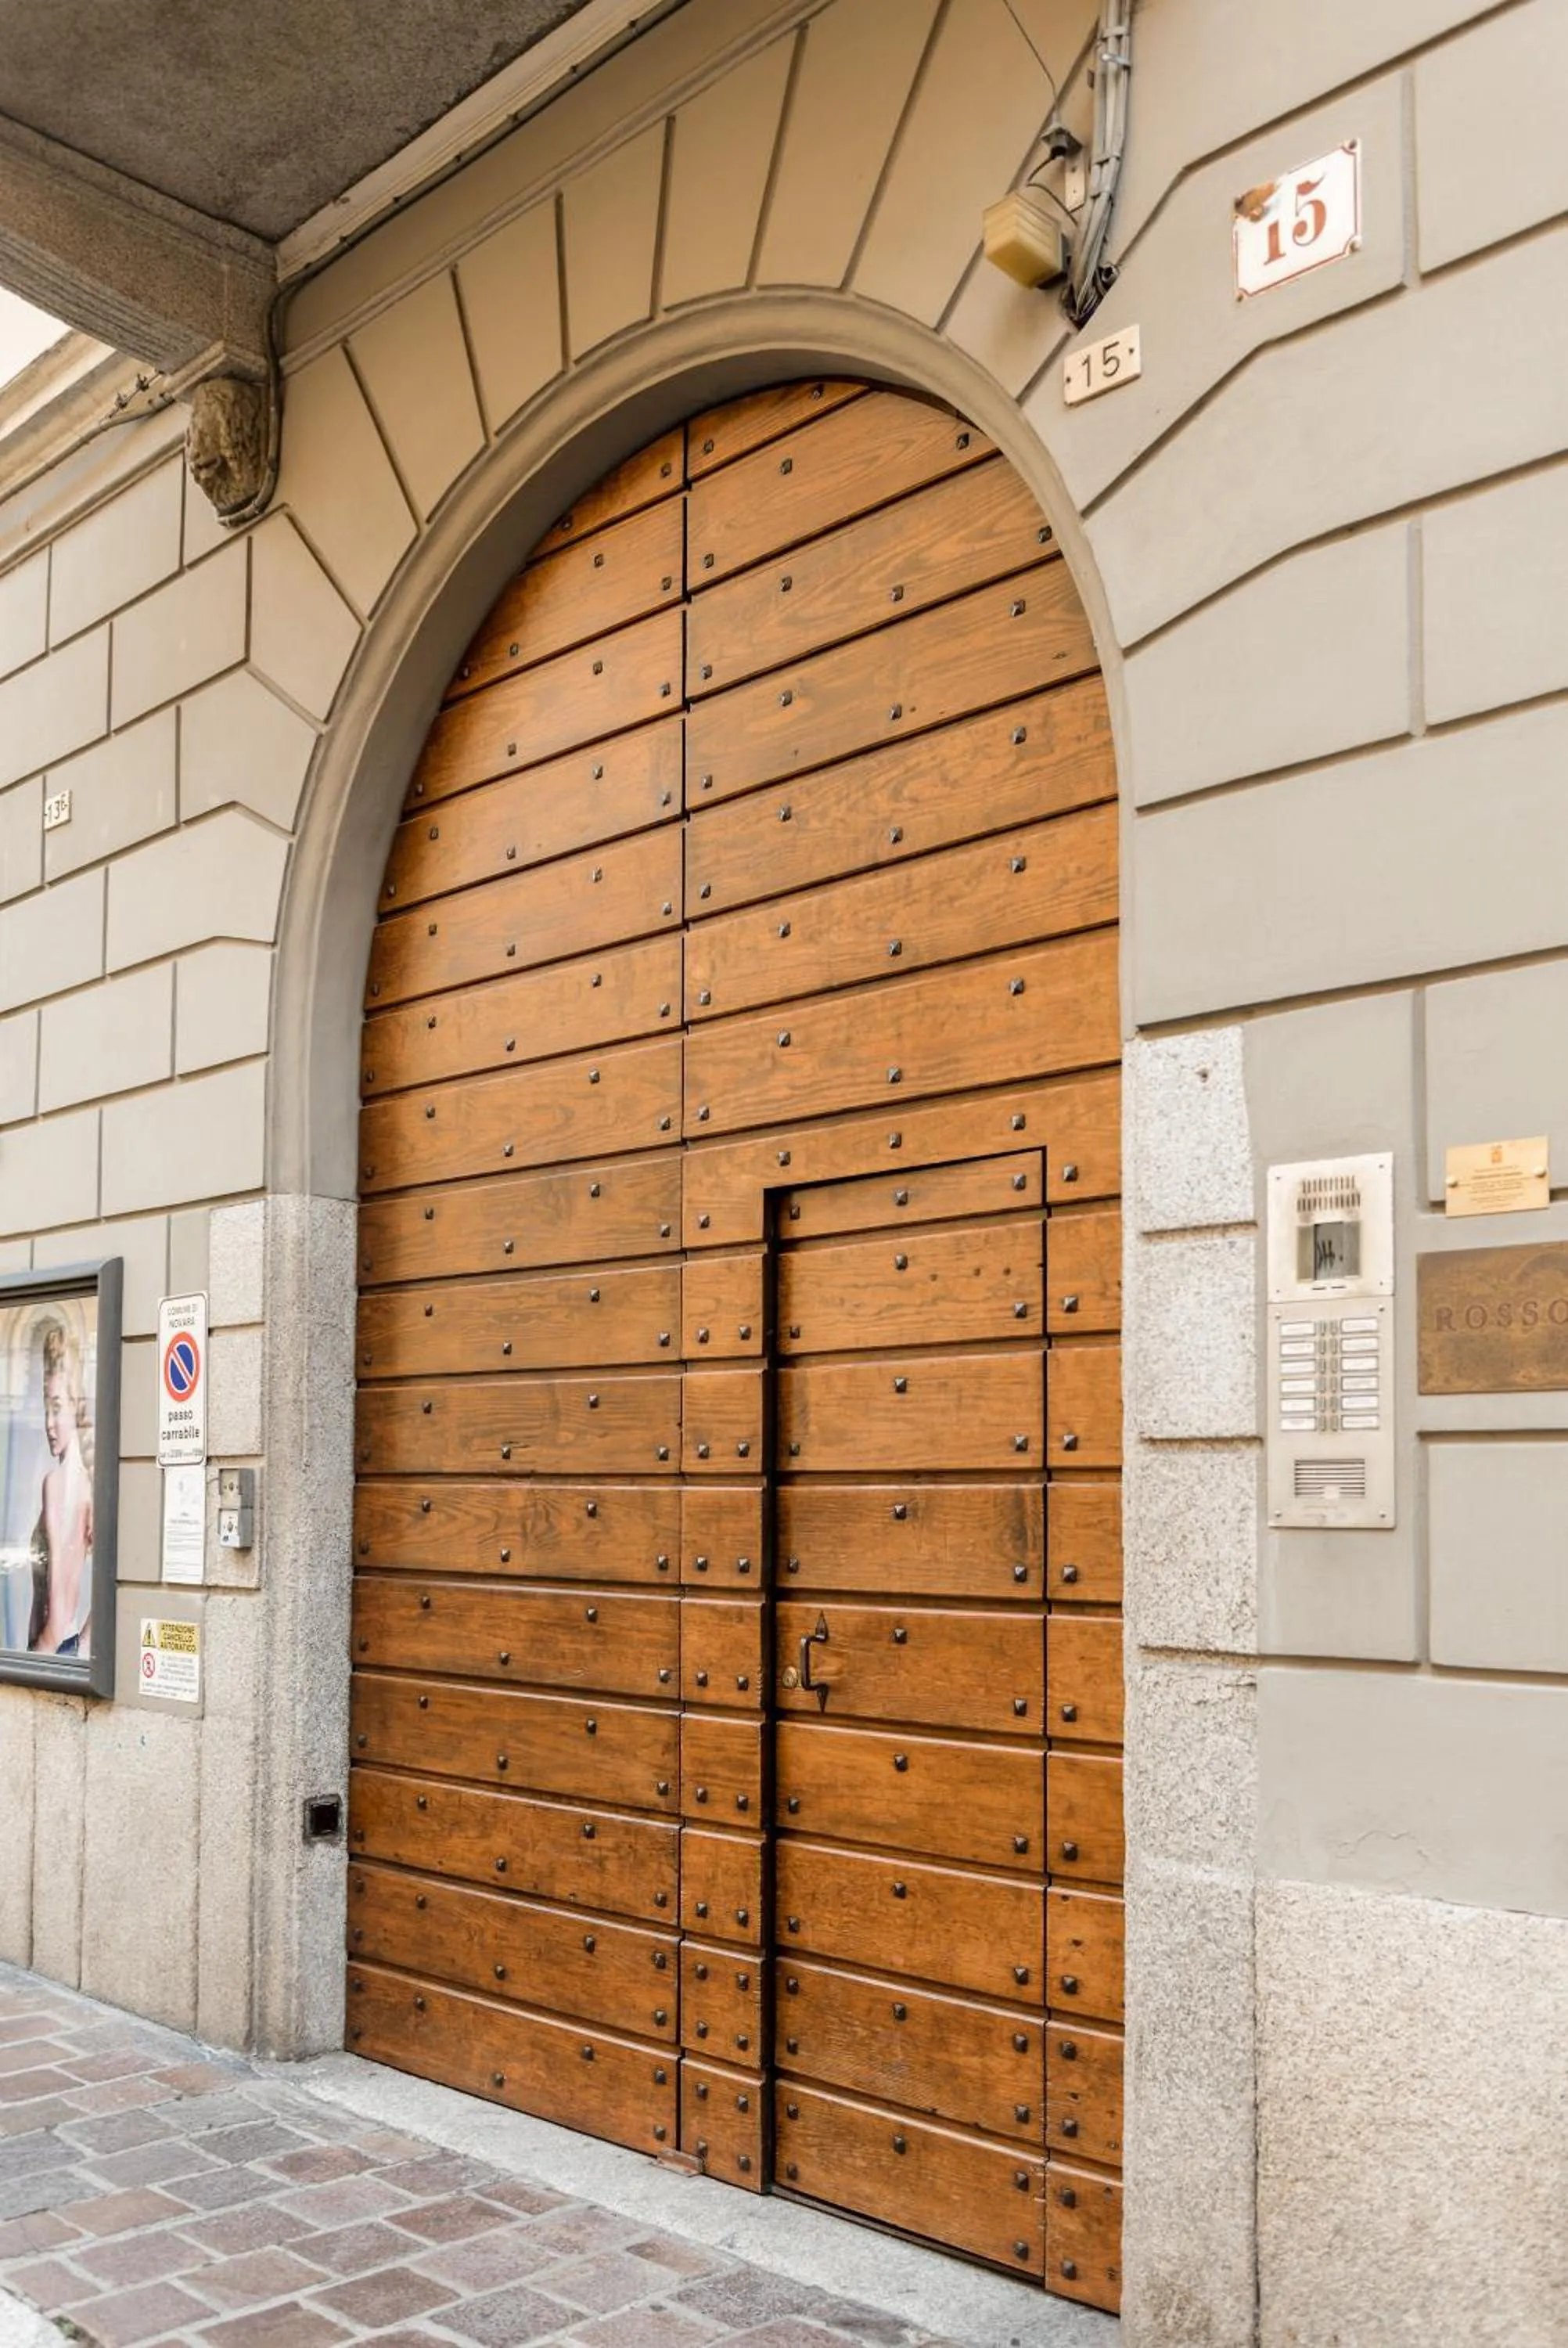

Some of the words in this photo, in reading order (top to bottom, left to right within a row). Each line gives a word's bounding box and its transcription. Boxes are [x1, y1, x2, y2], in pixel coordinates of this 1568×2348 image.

[1263, 171, 1328, 265] 15
[1081, 341, 1121, 387] 15
[168, 1410, 193, 1423] passo
[161, 1425, 200, 1441] carrabile
[161, 1623, 195, 1635] ATTENZIONE
[163, 1632, 193, 1643] CANCELLO
[160, 1641, 196, 1652] AUTOMATICO
